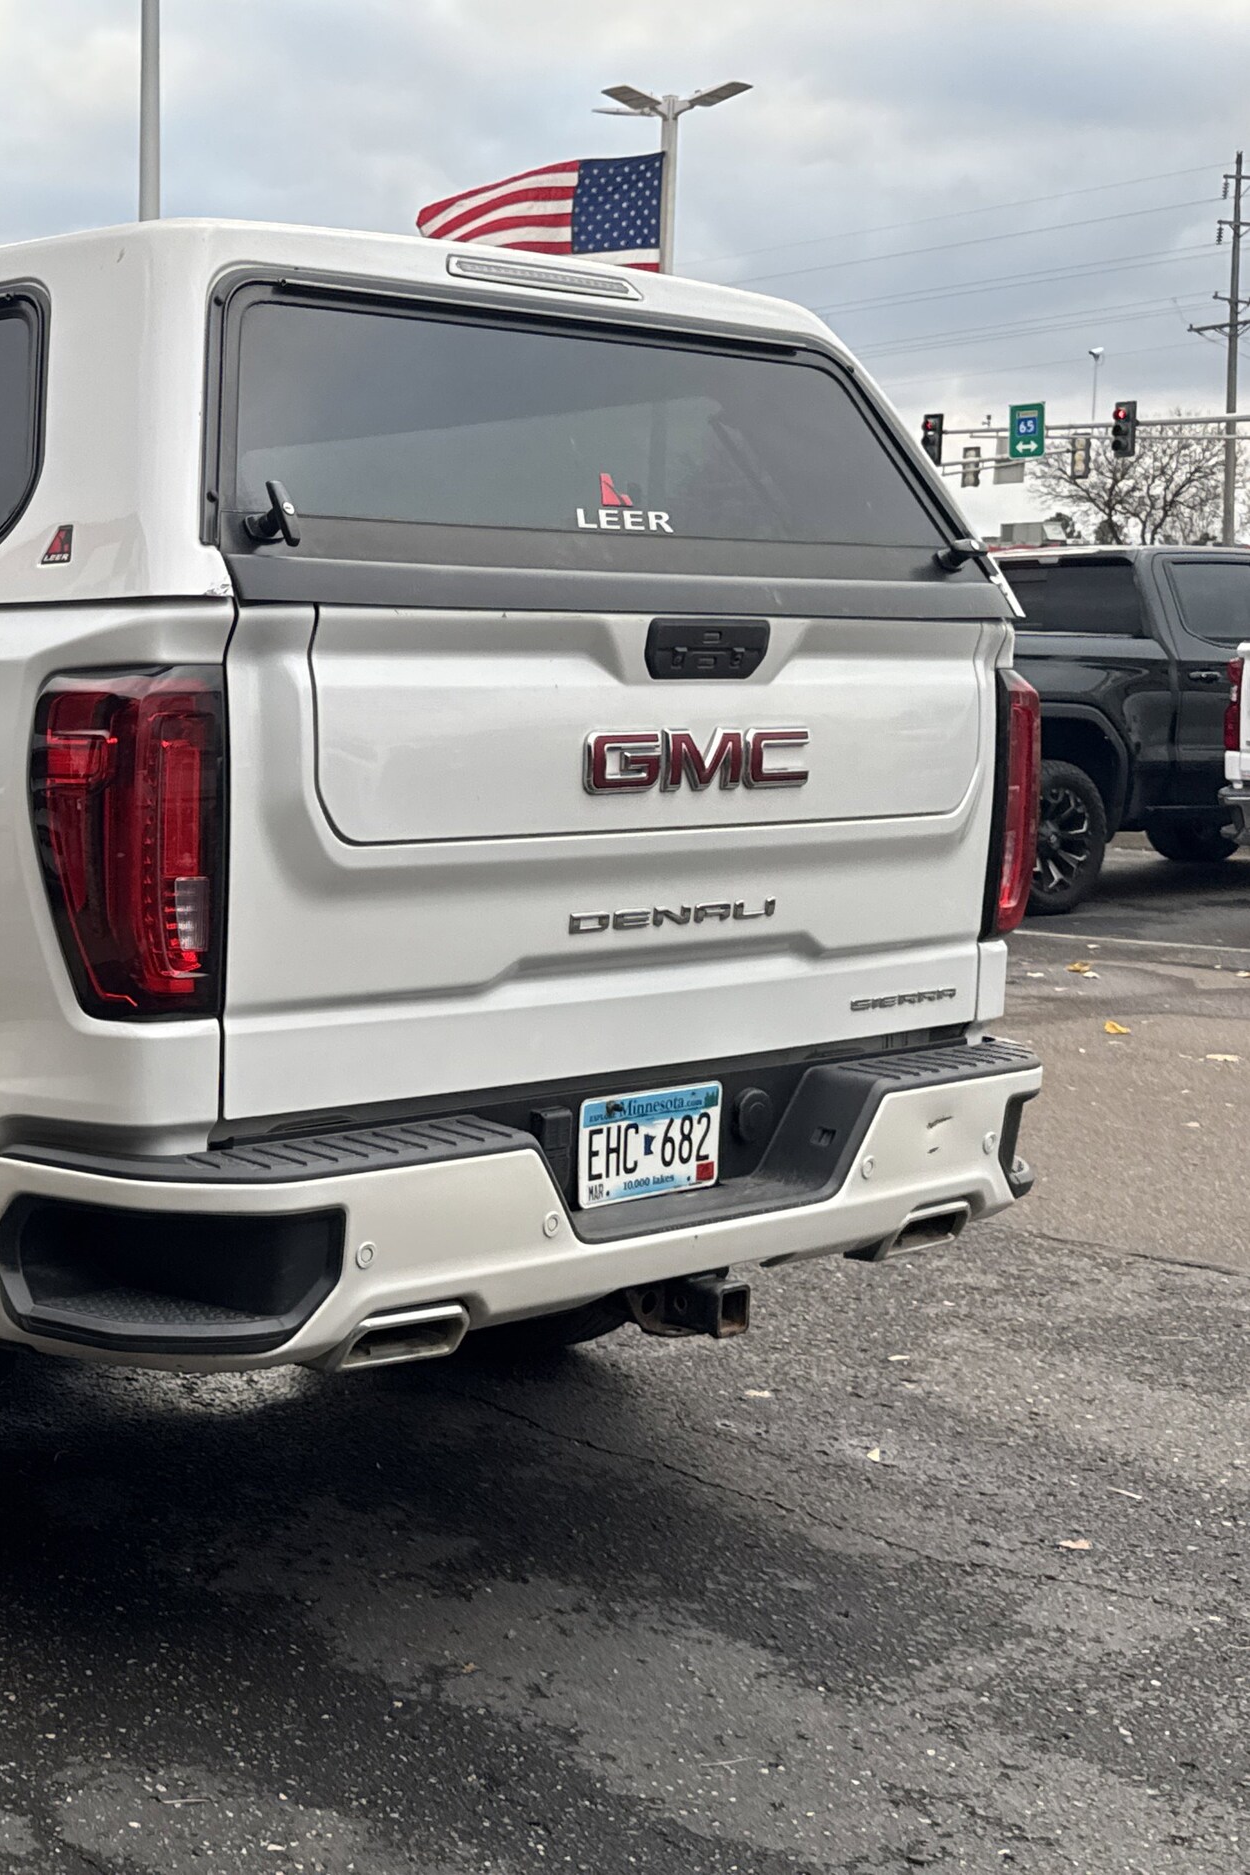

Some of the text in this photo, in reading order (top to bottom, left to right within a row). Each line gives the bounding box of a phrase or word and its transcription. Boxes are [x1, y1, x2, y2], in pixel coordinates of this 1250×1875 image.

[1019, 420, 1035, 433] 65
[576, 508, 674, 533] LEER
[43, 553, 69, 562] LEER
[582, 726, 810, 795] GMC
[568, 895, 776, 935] DENALI
[850, 987, 956, 1012] SIERRA
[588, 1112, 711, 1181] EHC 682
[588, 1183, 604, 1201] MAR
[652, 1174, 675, 1185] lakes
